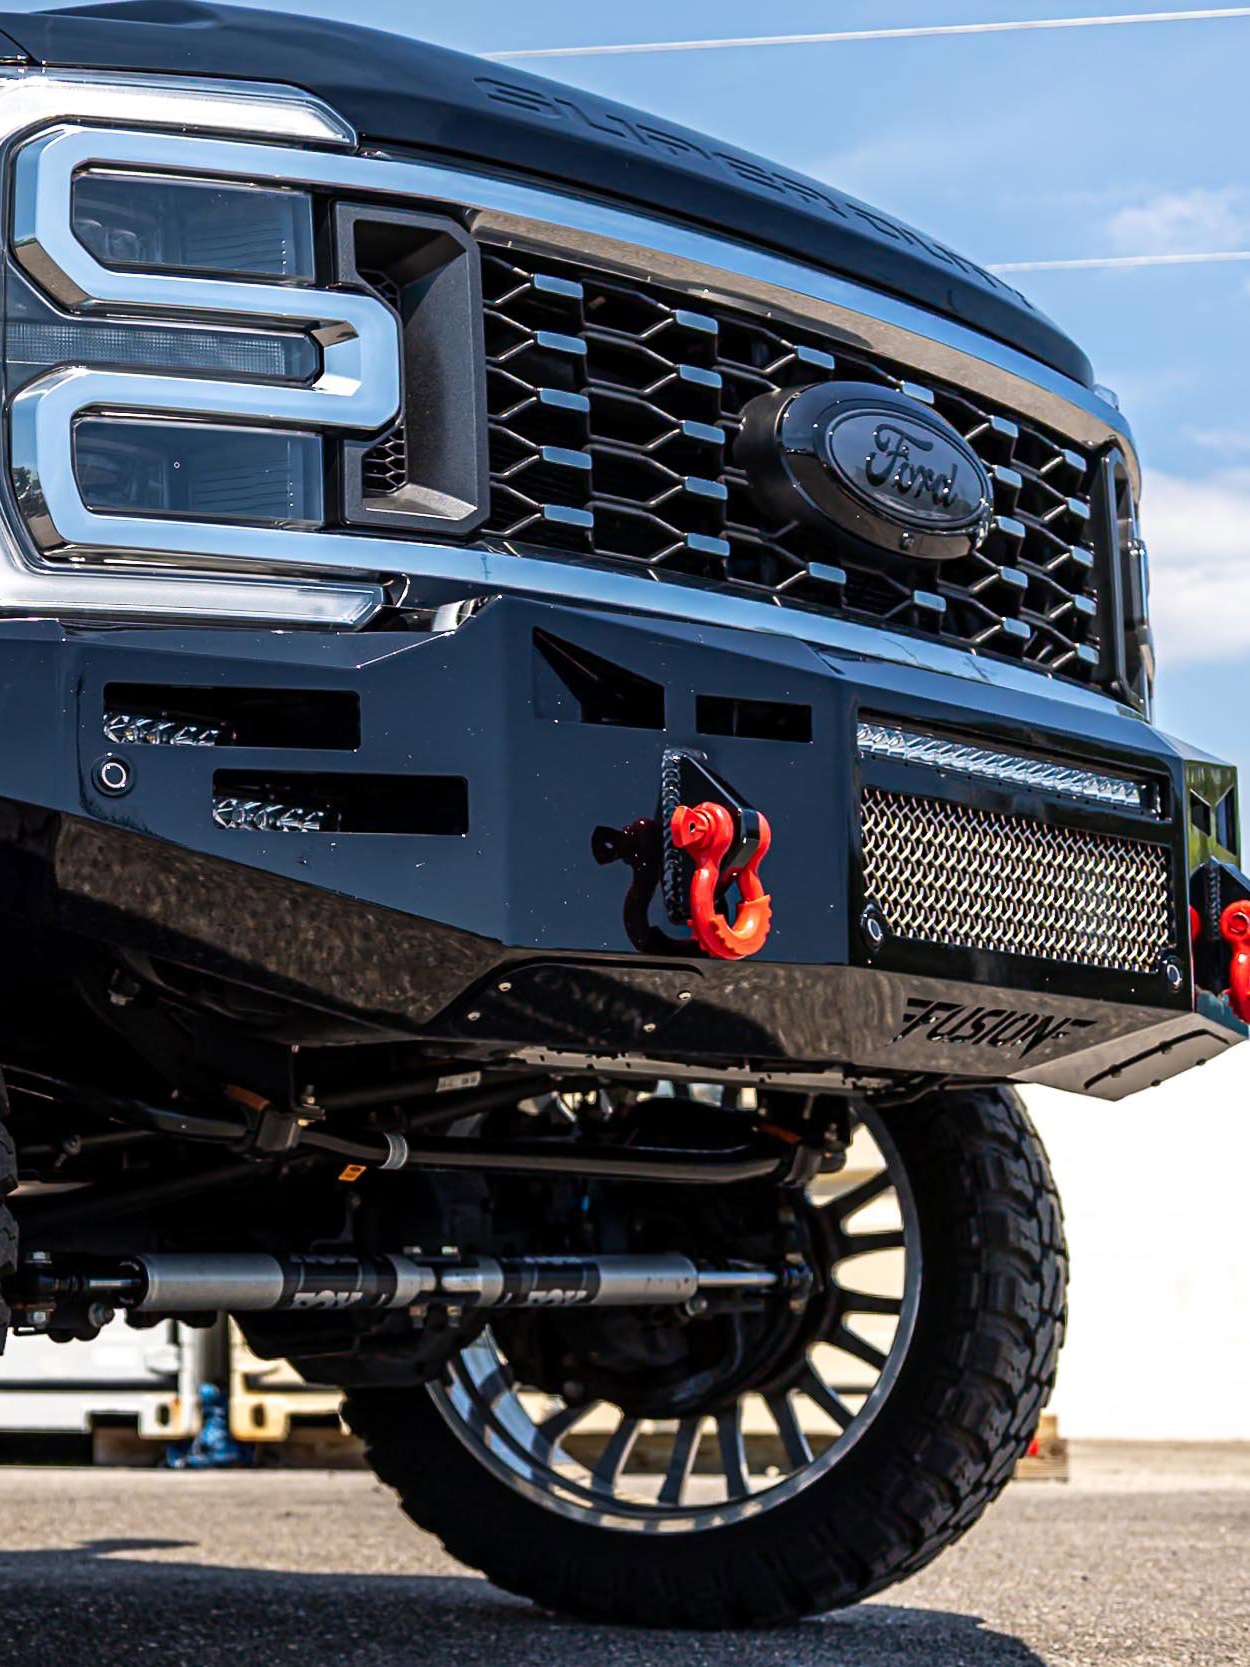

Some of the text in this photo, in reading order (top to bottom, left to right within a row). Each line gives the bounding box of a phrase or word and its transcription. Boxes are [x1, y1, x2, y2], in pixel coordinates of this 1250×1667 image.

[473, 77, 847, 219] SUPER
[865, 423, 959, 509] Ford
[888, 997, 1098, 1059] FUSION
